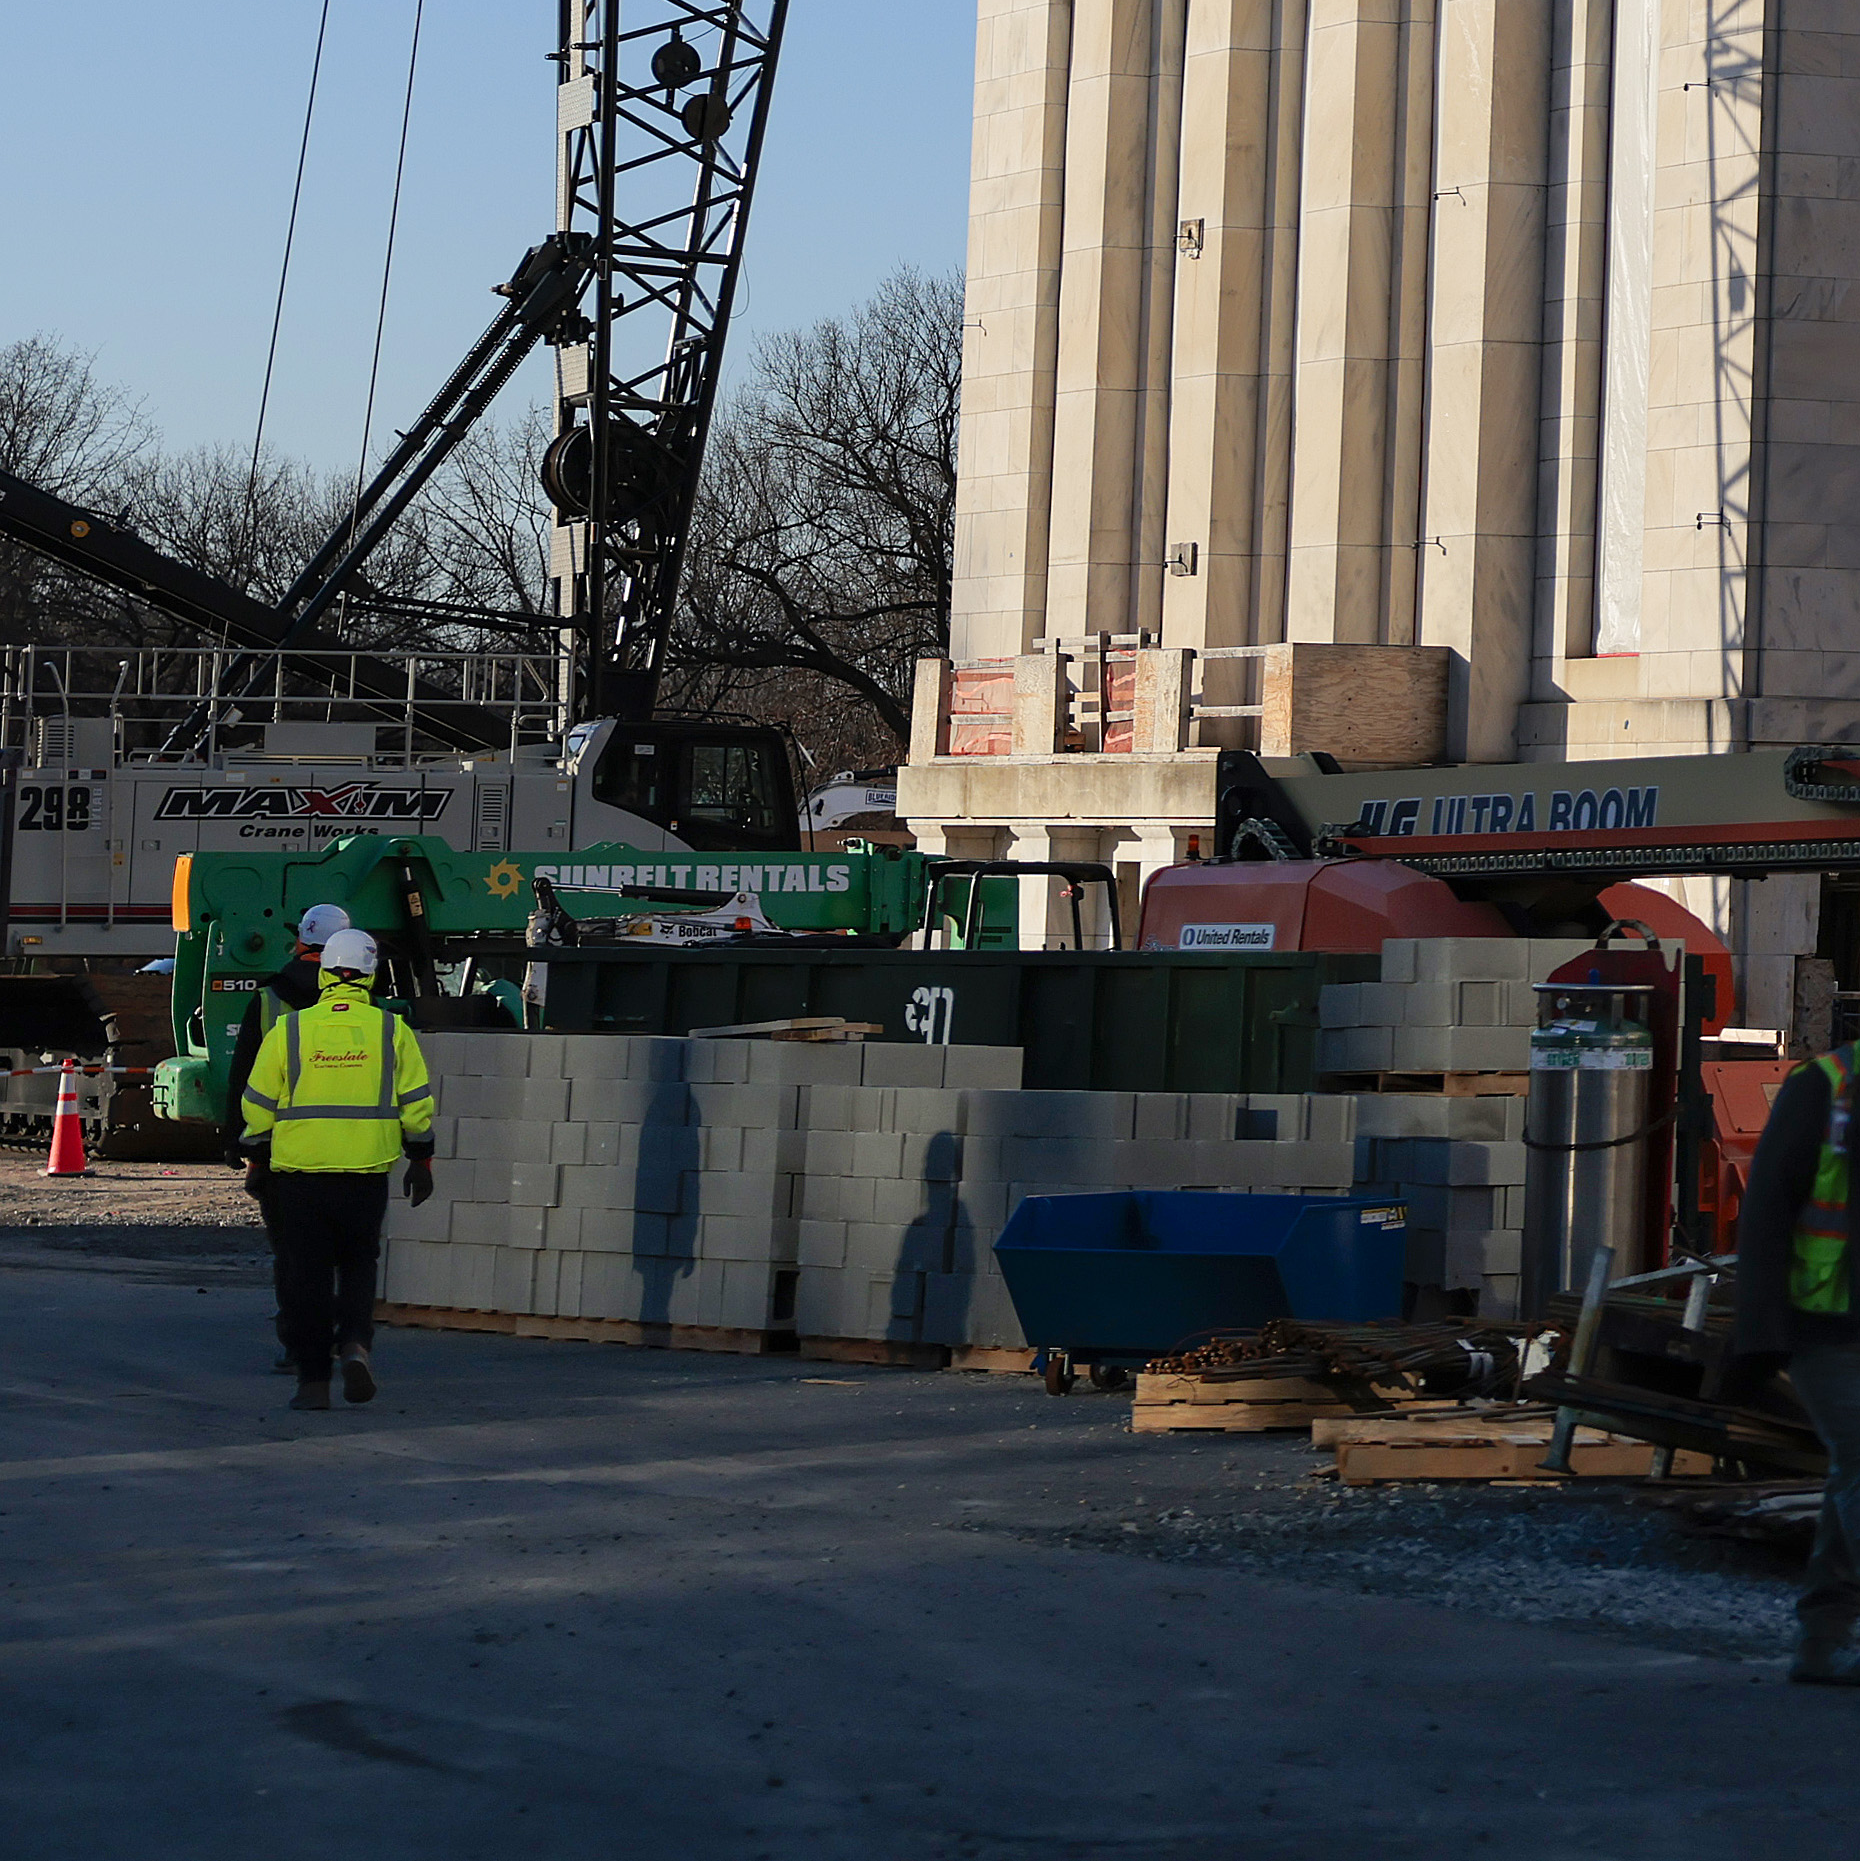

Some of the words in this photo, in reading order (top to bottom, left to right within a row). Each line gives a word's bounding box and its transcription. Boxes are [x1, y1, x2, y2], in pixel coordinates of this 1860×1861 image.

[18, 786, 90, 831] 298
[155, 782, 453, 820] MAXIM
[1431, 792, 1535, 835] ULTRA
[1550, 786, 1659, 831] BOOM
[239, 824, 304, 838] Crane
[314, 824, 379, 837] Works
[695, 865, 850, 892] RENTALS
[678, 925, 717, 937] Bobcat
[1196, 929, 1231, 945] United
[1231, 928, 1270, 944] Rentals
[223, 979, 257, 991] 510
